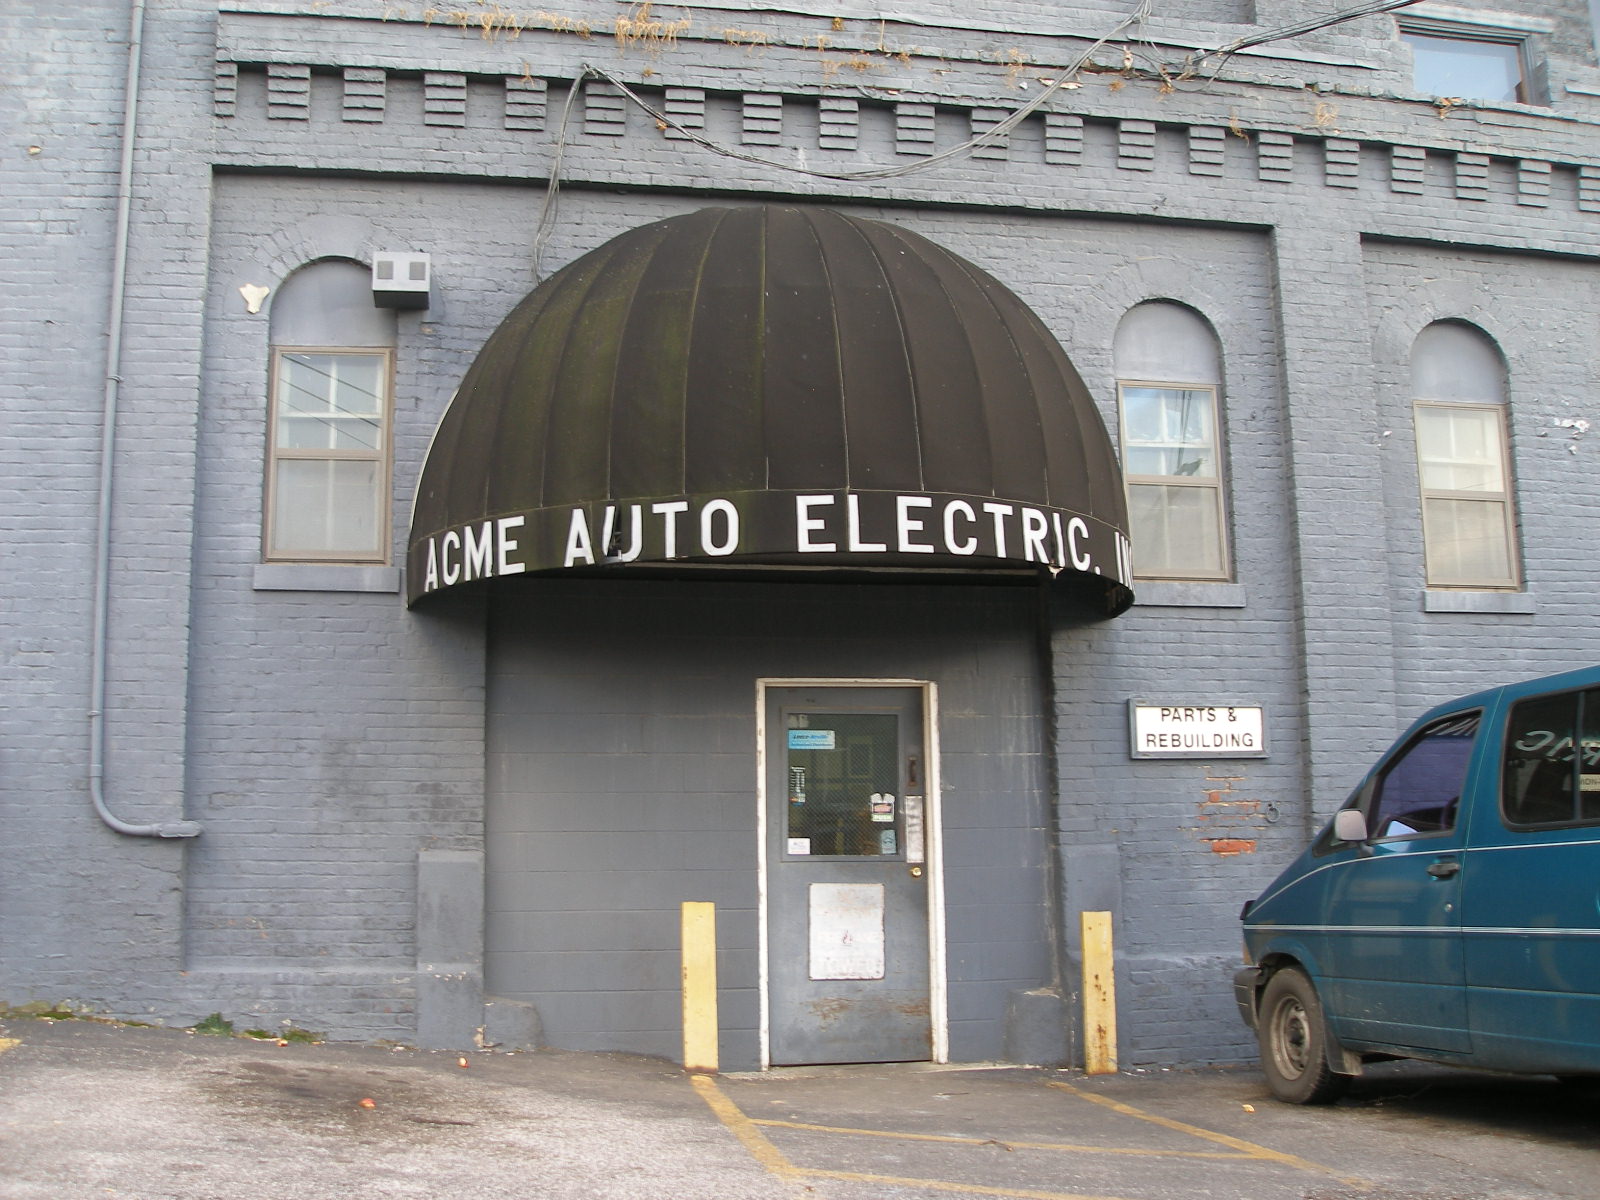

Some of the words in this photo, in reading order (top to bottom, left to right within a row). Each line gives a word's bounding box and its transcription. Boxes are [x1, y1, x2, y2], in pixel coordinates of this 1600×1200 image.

[424, 515, 526, 592] ACME
[564, 499, 740, 567] AUTO
[1161, 707, 1216, 722] PARTS
[1227, 706, 1237, 722] &
[1146, 732, 1254, 748] REBUILDING
